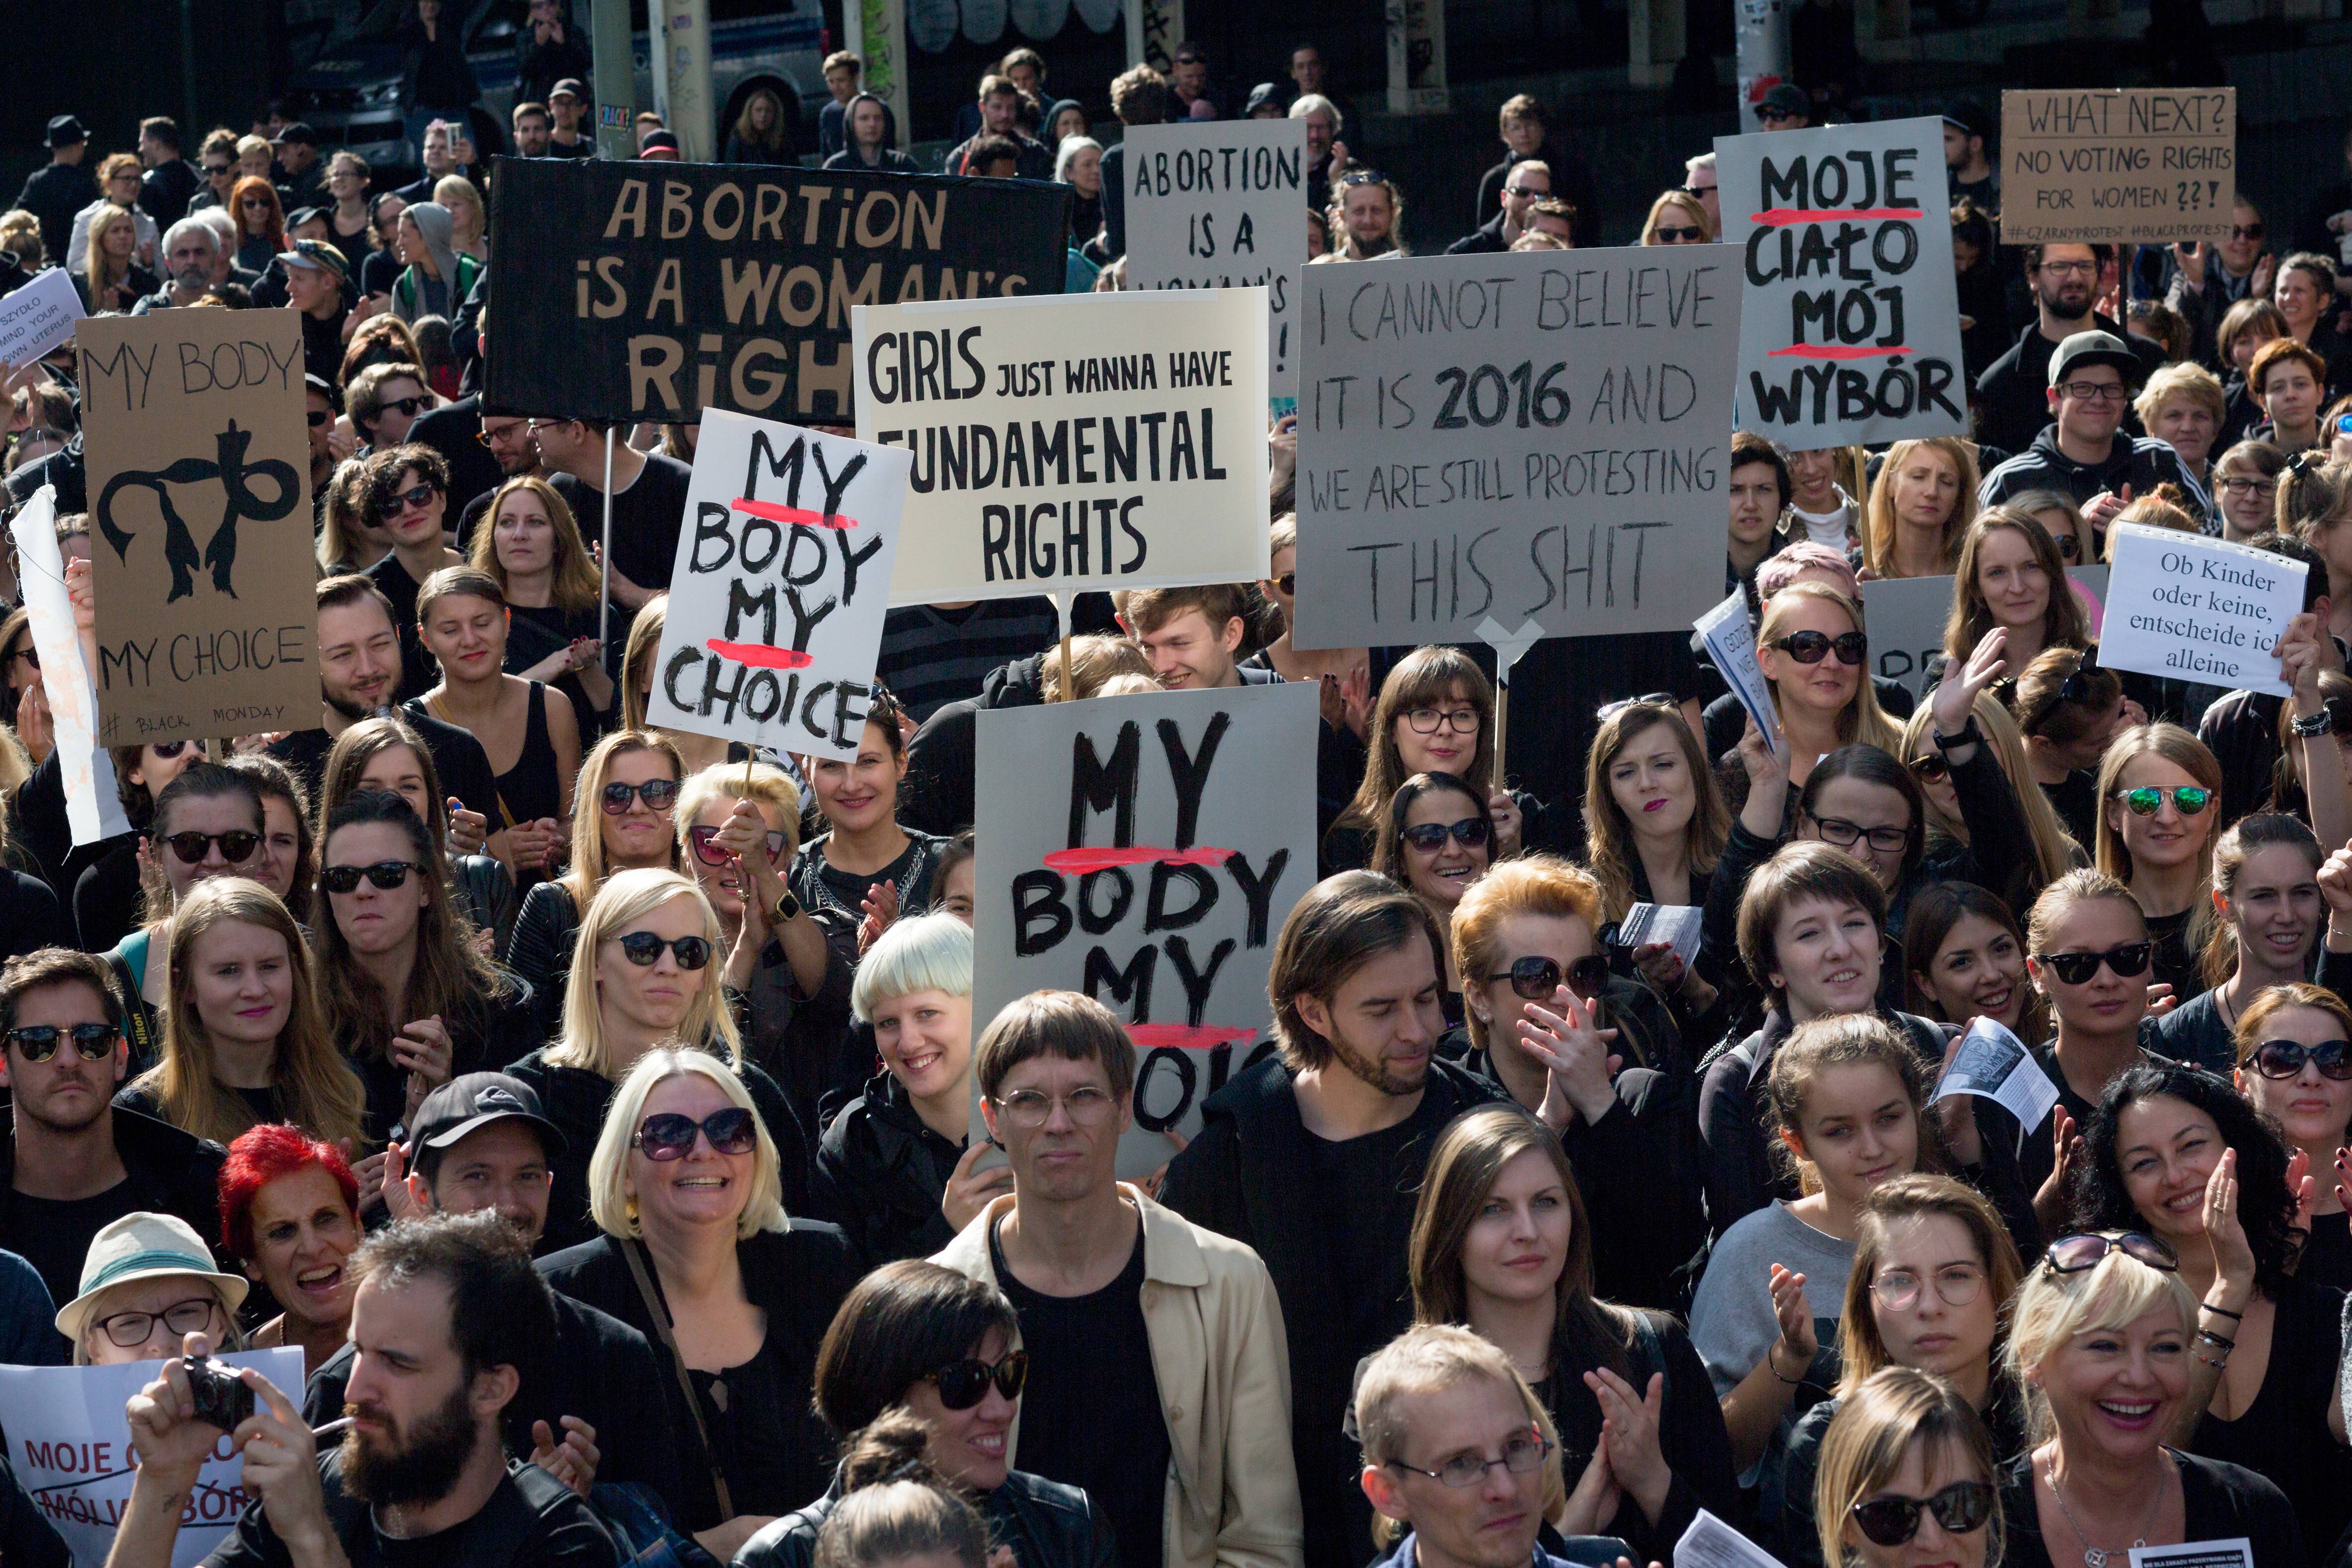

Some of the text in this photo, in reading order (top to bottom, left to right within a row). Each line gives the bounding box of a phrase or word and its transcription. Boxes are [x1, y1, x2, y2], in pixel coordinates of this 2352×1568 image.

[2028, 94, 2225, 134] WHAT NEXT?
[1134, 146, 1300, 197] ABORTION
[1761, 148, 1920, 213] MOJE
[2015, 146, 2232, 173] NO VOTING RIGHTS
[2037, 189, 2075, 209] FOR
[2091, 187, 2167, 208] WOMEN
[1189, 212, 1254, 258] IS A
[1745, 220, 1918, 287] CIAŁO
[2131, 224, 2230, 238] #BLACKPROTEST
[0, 297, 41, 326] SZYDŁO
[646, 259, 684, 325] A
[1319, 288, 1325, 346] I
[1348, 278, 1515, 341] CANNOT
[1537, 266, 1718, 331] BELIEVE
[1791, 280, 1904, 348] MÓJ
[0, 304, 59, 347] MIND YOUR
[2, 314, 71, 363] OWN UTERUS
[83, 339, 301, 412] MY BODY
[867, 326, 1232, 404] GIRLS JUST WANNA HAVE
[1315, 360, 1696, 432] IT IS 2016 AND
[1750, 355, 1963, 427] WYBÓR
[743, 430, 867, 528] MY
[1309, 446, 1717, 512] WE ARE STILL PROTESTING
[690, 502, 882, 607] BODY
[982, 495, 1147, 582] RIGHTS
[1347, 522, 1673, 623] THIS SHIT
[2152, 585, 2272, 624] oder keine,
[2161, 553, 2275, 592] Ob Kinder
[724, 577, 836, 664] MY
[2130, 614, 2245, 647] entscheide
[101, 626, 305, 690] MY CHOICE
[2166, 649, 2239, 677] alleine
[102, 706, 284, 740] # BLACK MONDAY
[664, 644, 870, 749] CHOICE
[1067, 712, 1233, 851] MY
[1011, 848, 1291, 958] BODY
[1082, 935, 1236, 1028] MY
[132, 1013, 148, 1044] Nikon
[25, 1440, 112, 1473] MOJE
